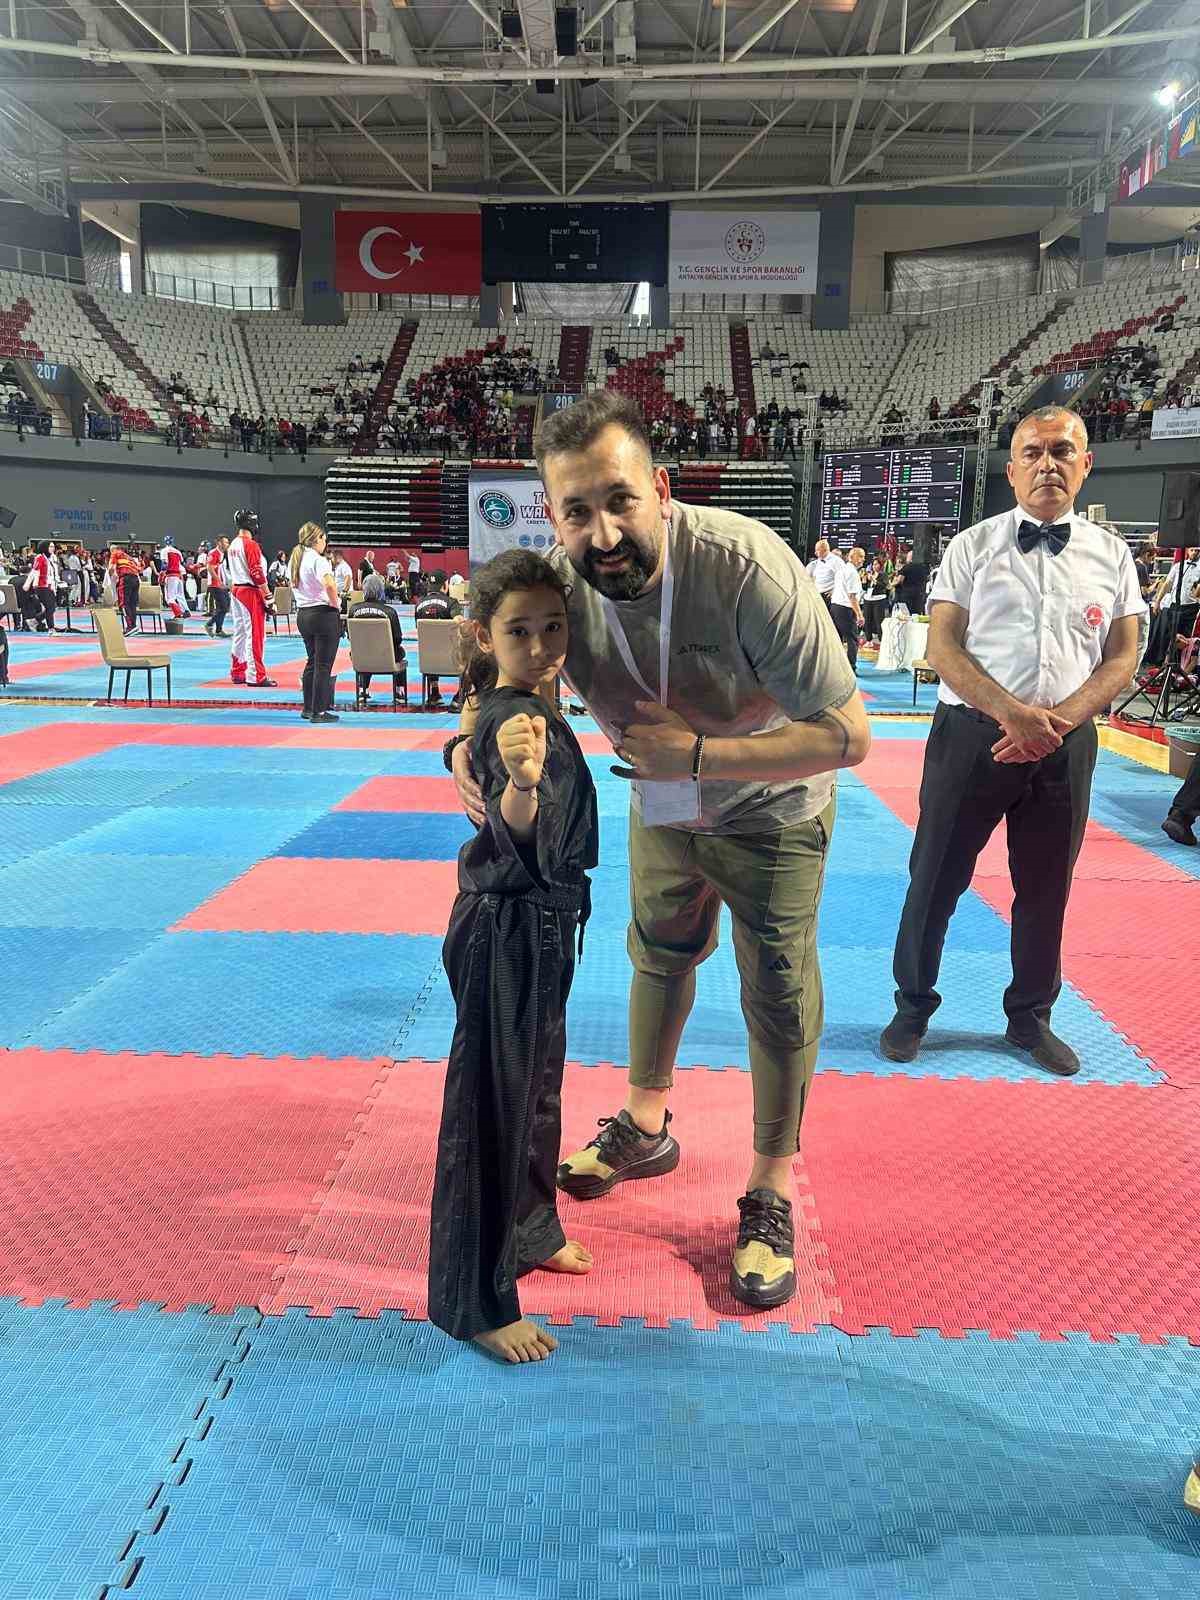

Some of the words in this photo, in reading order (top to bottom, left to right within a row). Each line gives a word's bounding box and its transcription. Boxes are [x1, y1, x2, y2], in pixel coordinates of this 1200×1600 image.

[678, 265, 693, 273] T.C.
[730, 265, 741, 273] VE
[742, 266, 763, 274] SPOR
[36, 363, 58, 380] 207
